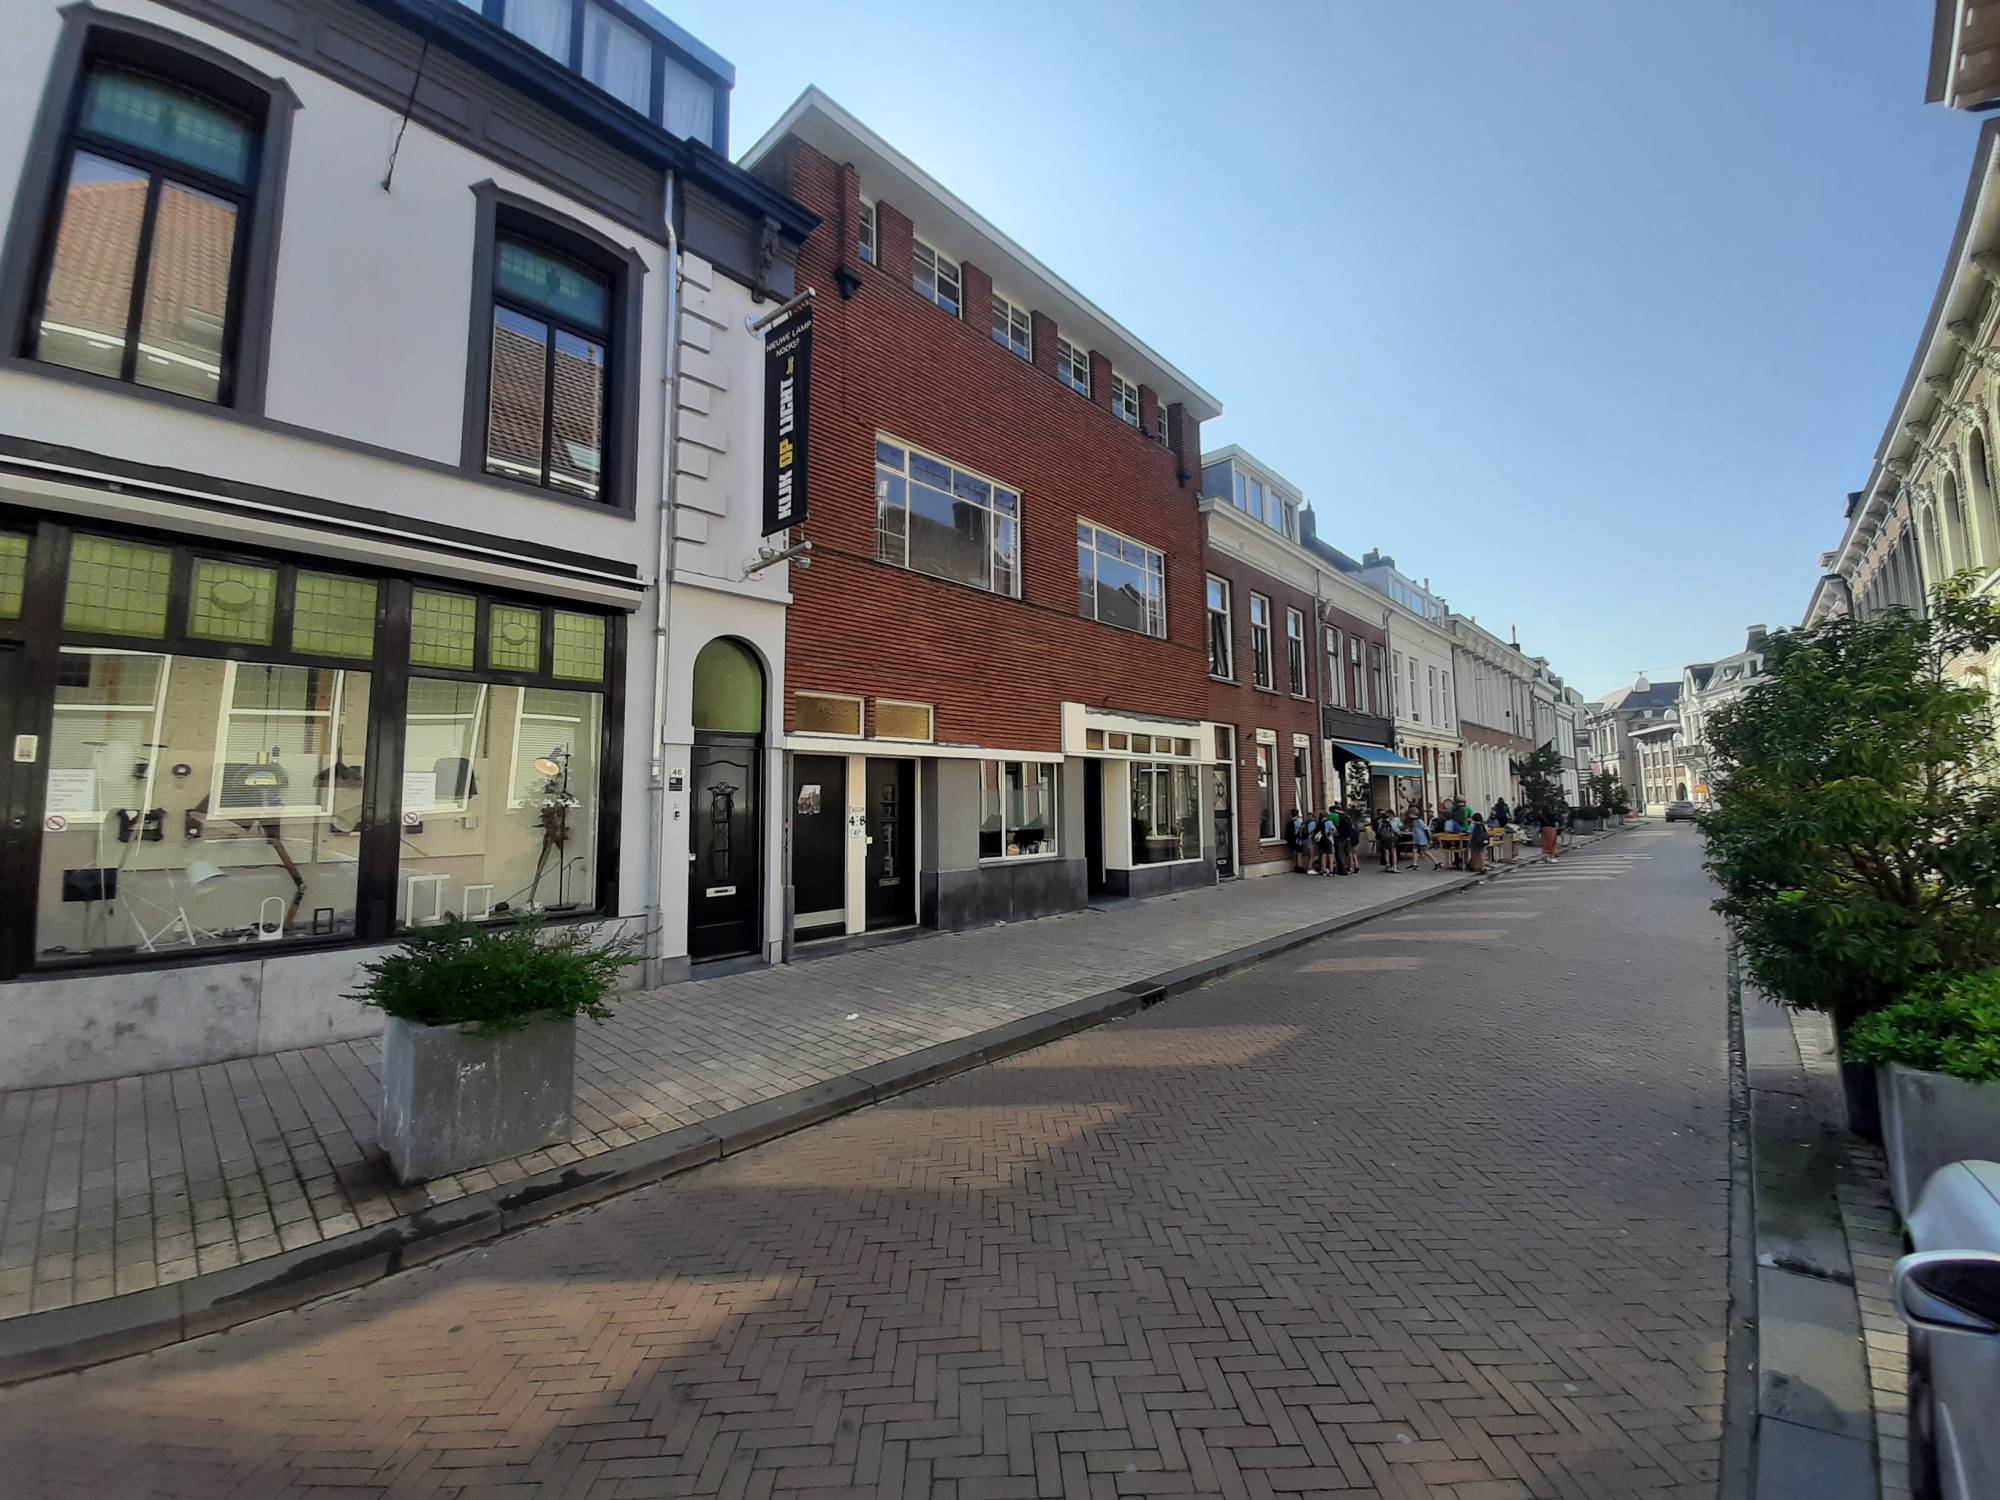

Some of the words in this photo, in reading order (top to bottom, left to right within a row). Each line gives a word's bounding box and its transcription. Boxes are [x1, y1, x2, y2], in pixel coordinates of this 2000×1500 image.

[766, 332, 791, 353] NIEUWE
[791, 320, 812, 338] LAMP
[776, 338, 800, 358] NODIG?
[780, 377, 794, 436] LICHT
[779, 438, 793, 469] OP
[778, 469, 792, 520] KIJK
